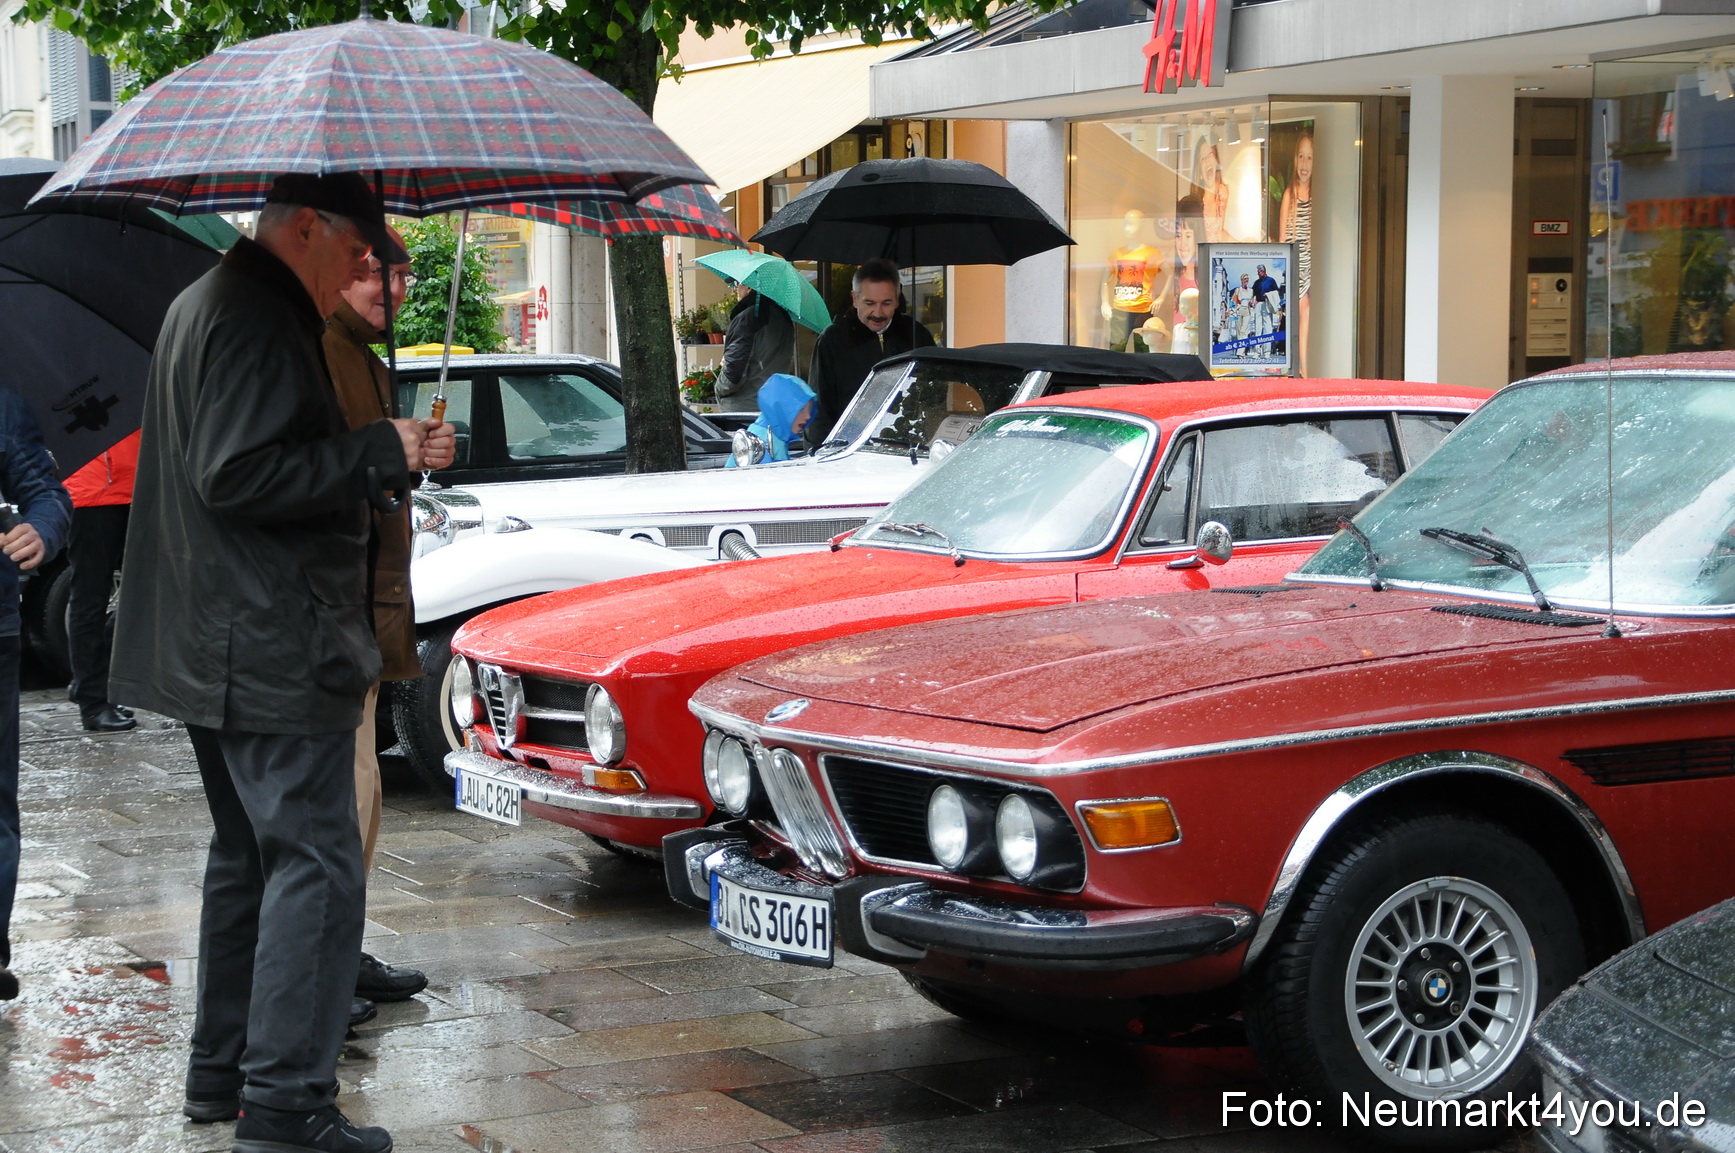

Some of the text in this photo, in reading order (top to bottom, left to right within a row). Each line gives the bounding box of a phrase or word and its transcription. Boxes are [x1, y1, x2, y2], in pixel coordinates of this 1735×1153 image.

[1142, 0, 1217, 94] H&M
[1541, 223, 1561, 232] BMZ
[1257, 335, 1275, 344] Monat
[461, 775, 519, 820] LAU C 82H
[739, 892, 761, 939] CS
[765, 898, 827, 951] 306H
